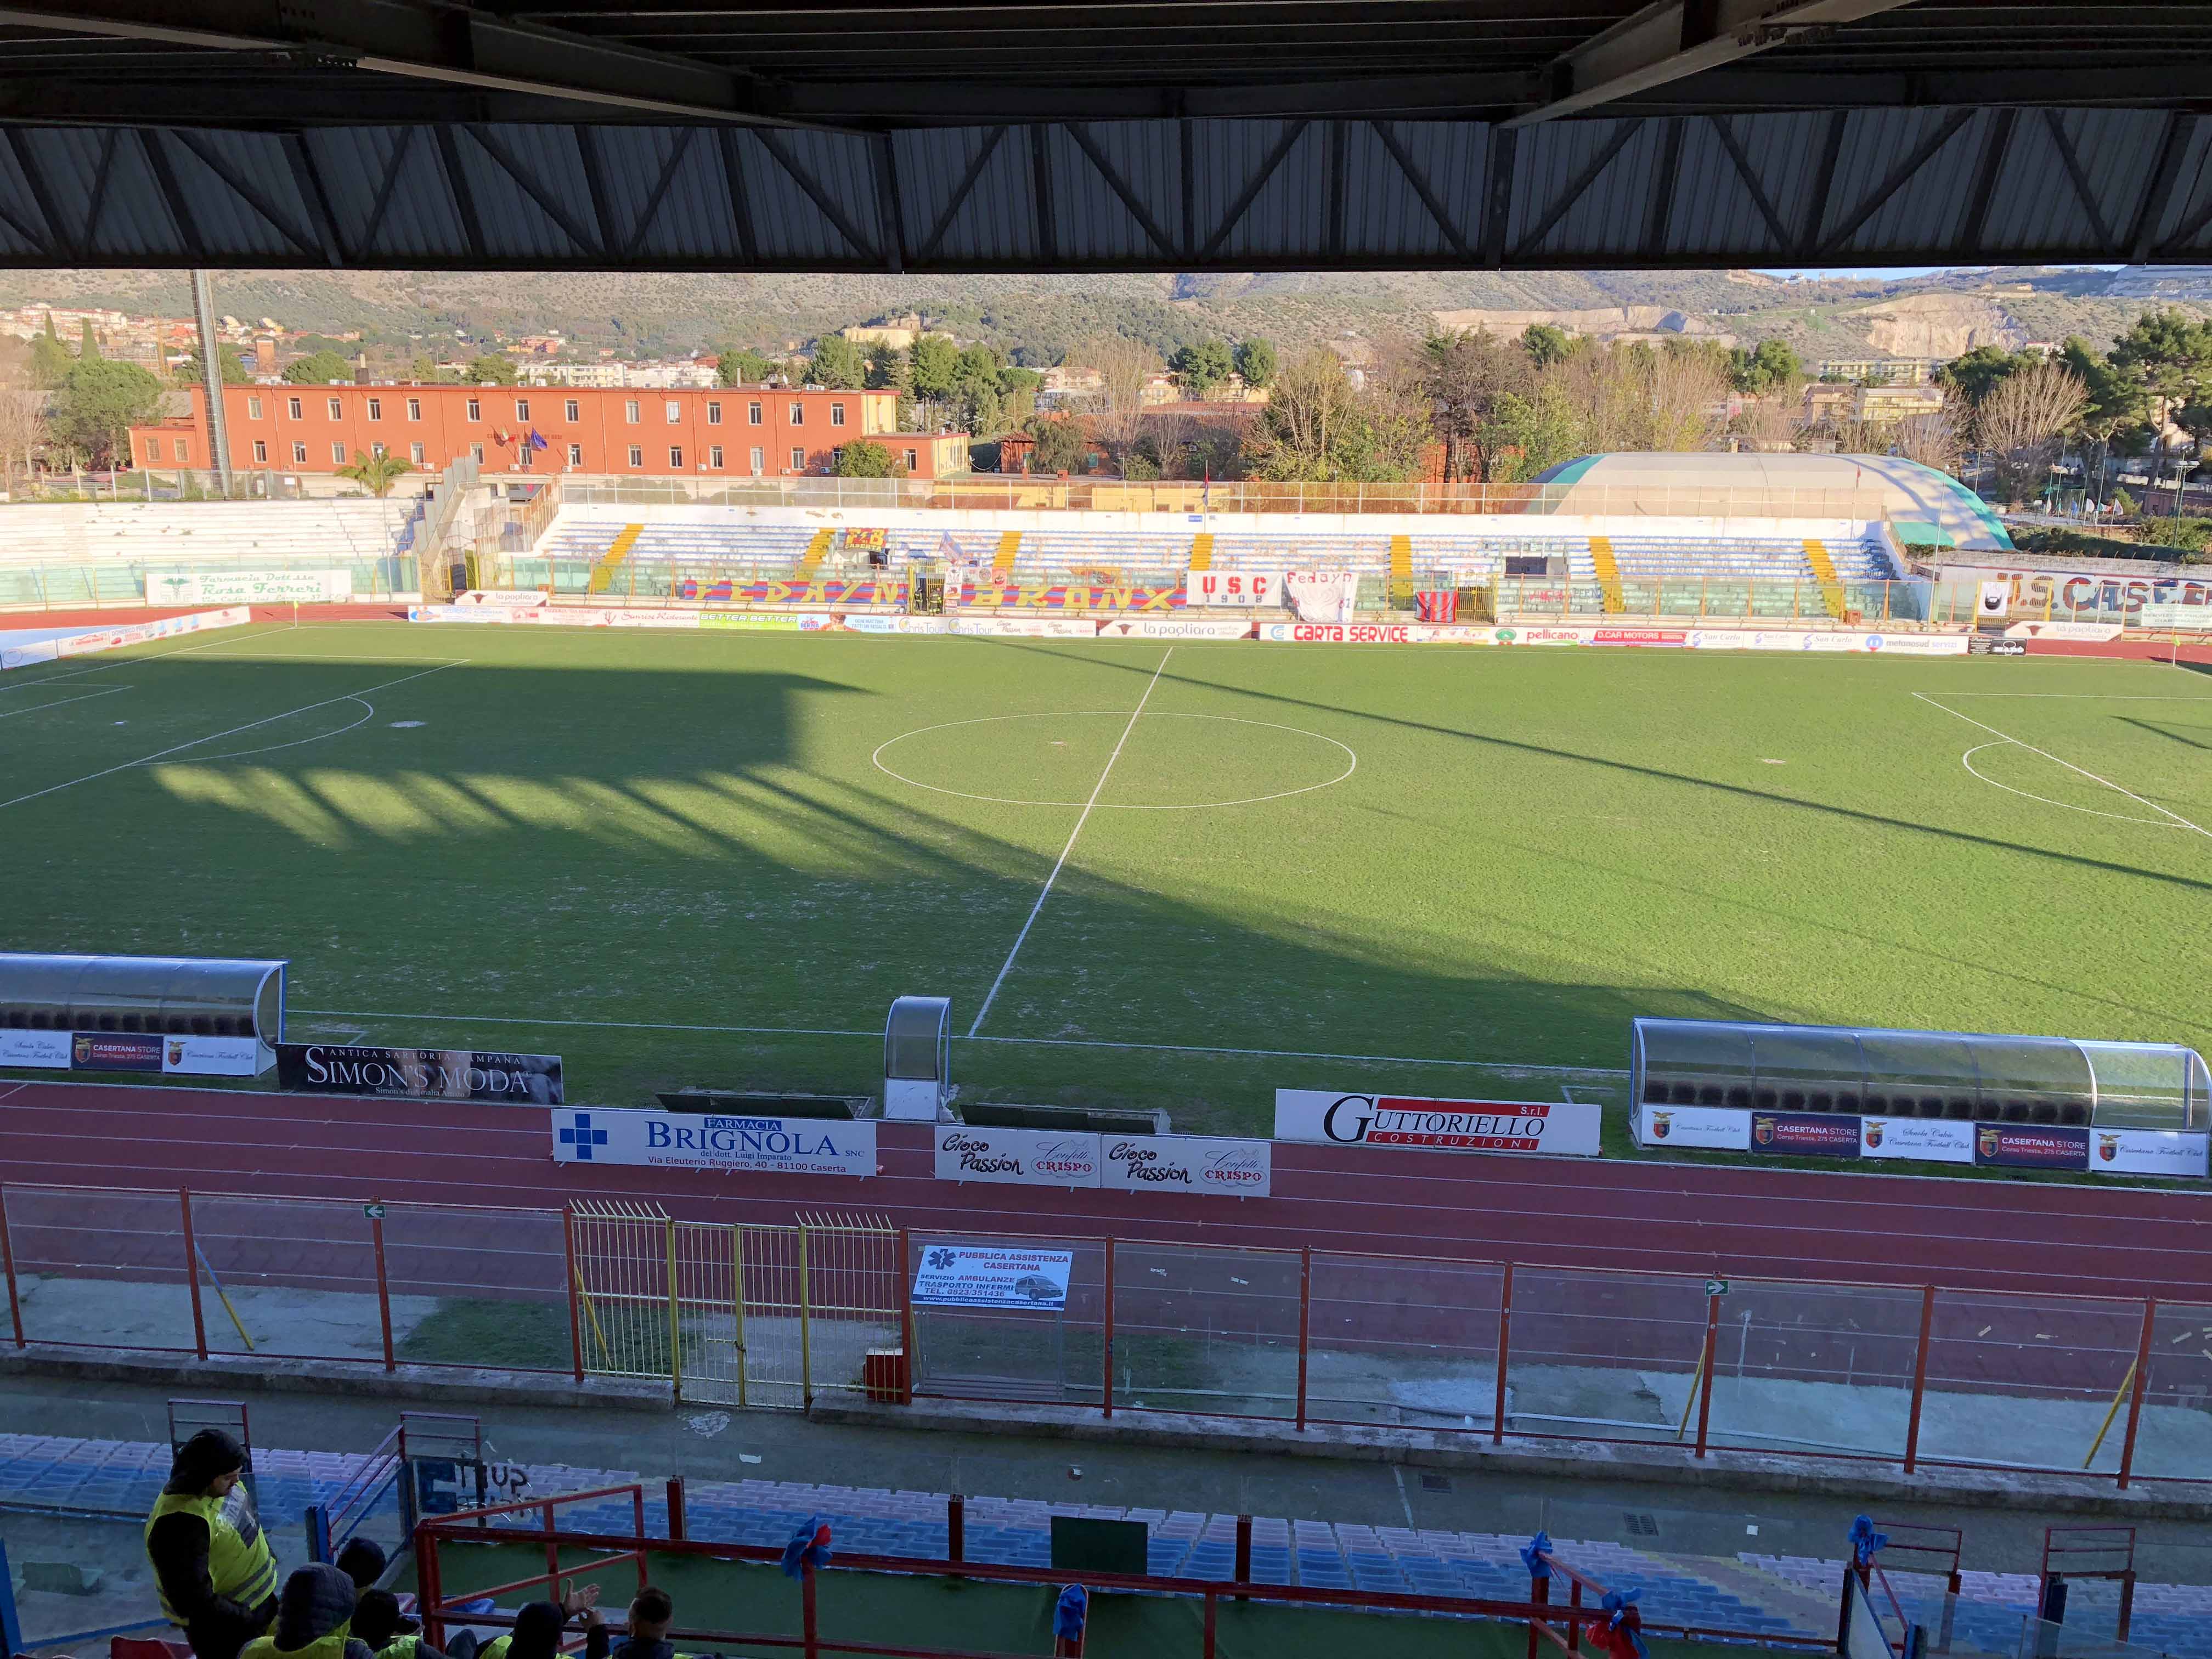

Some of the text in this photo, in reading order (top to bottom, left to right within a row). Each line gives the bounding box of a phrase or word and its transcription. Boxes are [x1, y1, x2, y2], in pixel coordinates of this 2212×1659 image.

[1287, 571, 1352, 584] Fedayn
[201, 583, 246, 595] Rosa
[1203, 576, 1267, 594] USC
[696, 580, 1176, 610] FEDAYN BRONX
[1205, 594, 1262, 603] 1908
[700, 613, 747, 622] BETTER
[1144, 623, 1156, 634] la
[1159, 623, 1215, 637] pagliara
[1294, 625, 1409, 643] CARTA SERVICE
[1527, 629, 1578, 642] pellicano
[1932, 640, 1958, 649] servizi
[330, 1048, 379, 1059] ANTICA
[385, 1050, 453, 1062] SARTORIA
[304, 1046, 529, 1094] SIMON'S MODA
[1520, 1105, 1543, 1116] S.r.l.
[707, 1119, 778, 1131] FARMACIA
[1323, 1094, 1545, 1143] GUTTORIELLO
[1777, 1125, 1858, 1136] CASERTANA STORE
[645, 1120, 865, 1158] BRIGNOLA SNC
[941, 1132, 990, 1153] Cioco
[1373, 1132, 1534, 1149] COSTRUZIONI
[2002, 1137, 2086, 1149] CASERTANA STORE
[700, 1149, 713, 1158] del
[735, 1152, 755, 1161] Luigi
[757, 1153, 792, 1162] Imparato
[1108, 1141, 1158, 1161] Cioco
[2056, 1149, 2085, 1157] CASERTA
[665, 1156, 707, 1167] Eleuterio
[708, 1158, 753, 1170] Ruggiero,
[754, 1160, 769, 1169] 40
[776, 1161, 808, 1171] 81100
[810, 1164, 847, 1173] Caserta
[960, 1152, 1024, 1176] Passion
[1036, 1160, 1092, 1172] CRISPO
[1127, 1160, 1193, 1185] Passion
[1204, 1169, 1263, 1182] CRISPO
[958, 1251, 1069, 1263] PUBBLICA ASSISTENZA
[983, 1261, 1041, 1272] CASERTANA
[957, 1274, 1015, 1283] AMBULANZE
[918, 1280, 1014, 1291] TRASPORTO INFERMI
[947, 1288, 1006, 1297] 0823/351436
[923, 1295, 1054, 1307] www.pubblicaassistenzacasertana.it
